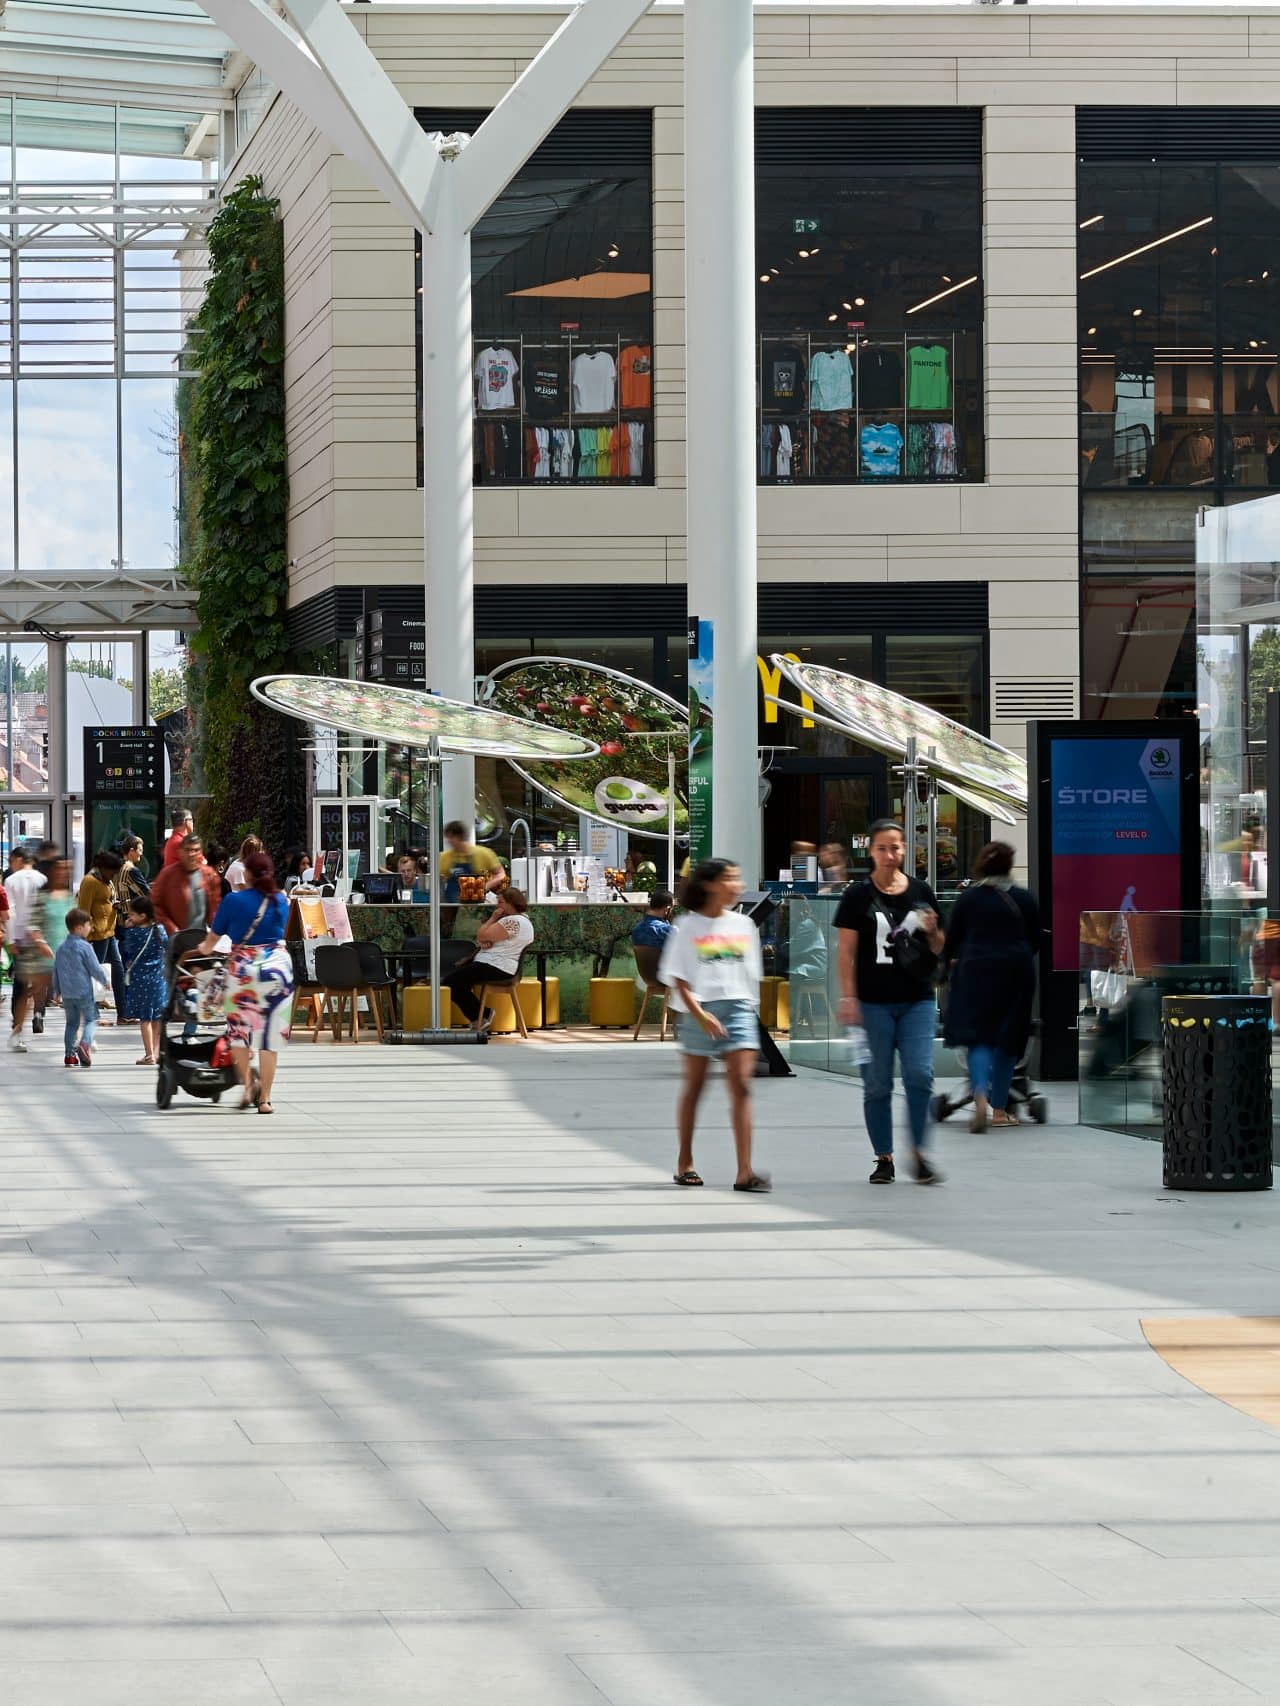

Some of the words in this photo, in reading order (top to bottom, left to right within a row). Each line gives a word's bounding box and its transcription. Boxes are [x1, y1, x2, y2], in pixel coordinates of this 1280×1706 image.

[409, 642, 425, 651] FOOD
[96, 742, 104, 764] 1
[1057, 786, 1148, 804] ŠTORE
[1115, 831, 1139, 839] LEVEL
